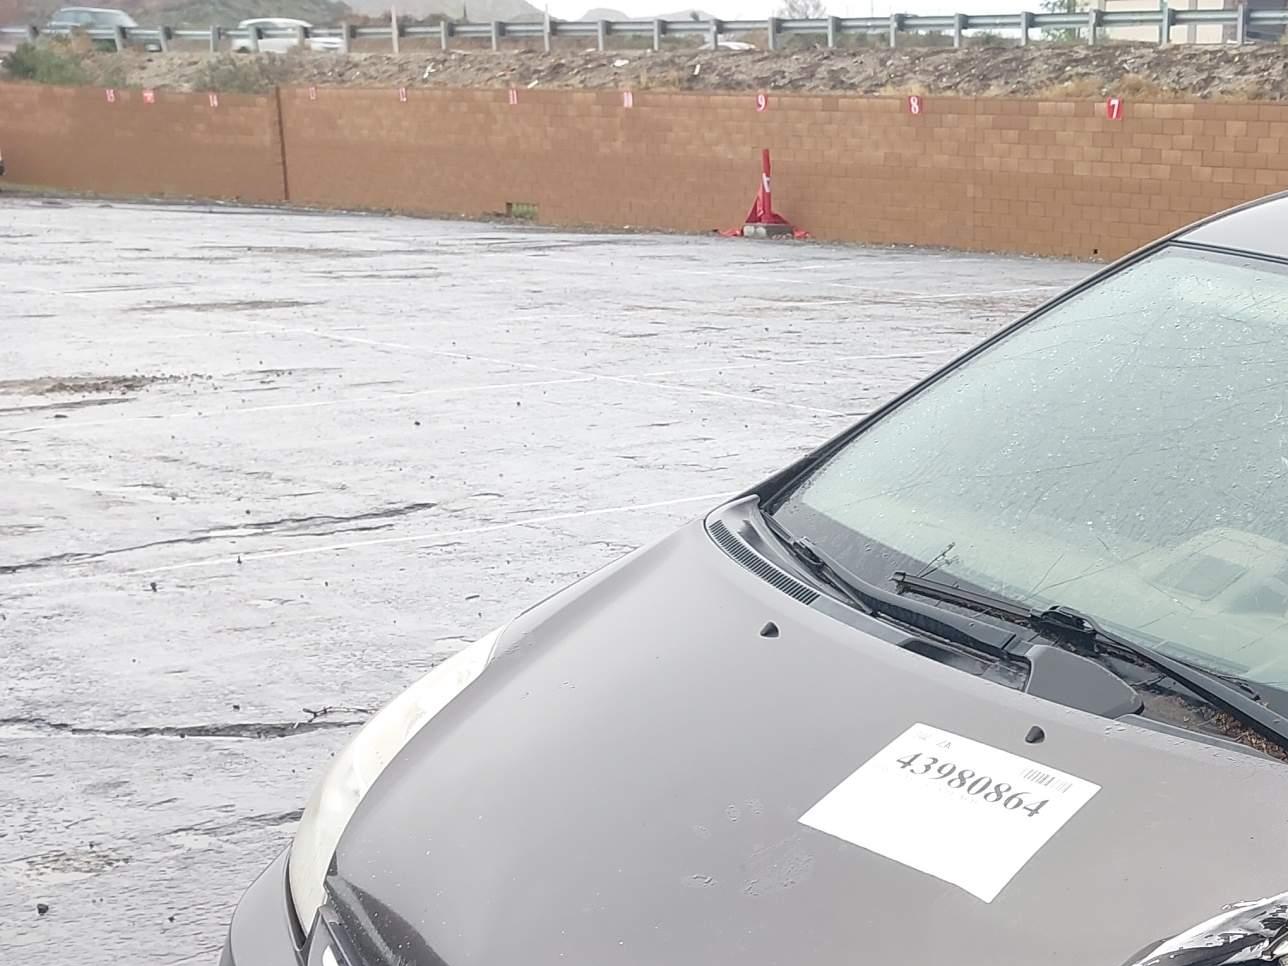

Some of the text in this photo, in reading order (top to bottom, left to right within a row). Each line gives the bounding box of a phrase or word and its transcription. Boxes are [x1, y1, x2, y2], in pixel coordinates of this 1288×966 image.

[757, 94, 766, 111] 9
[910, 96, 919, 114] 8
[1109, 99, 1120, 120] 7
[896, 752, 1050, 817] 43980864
